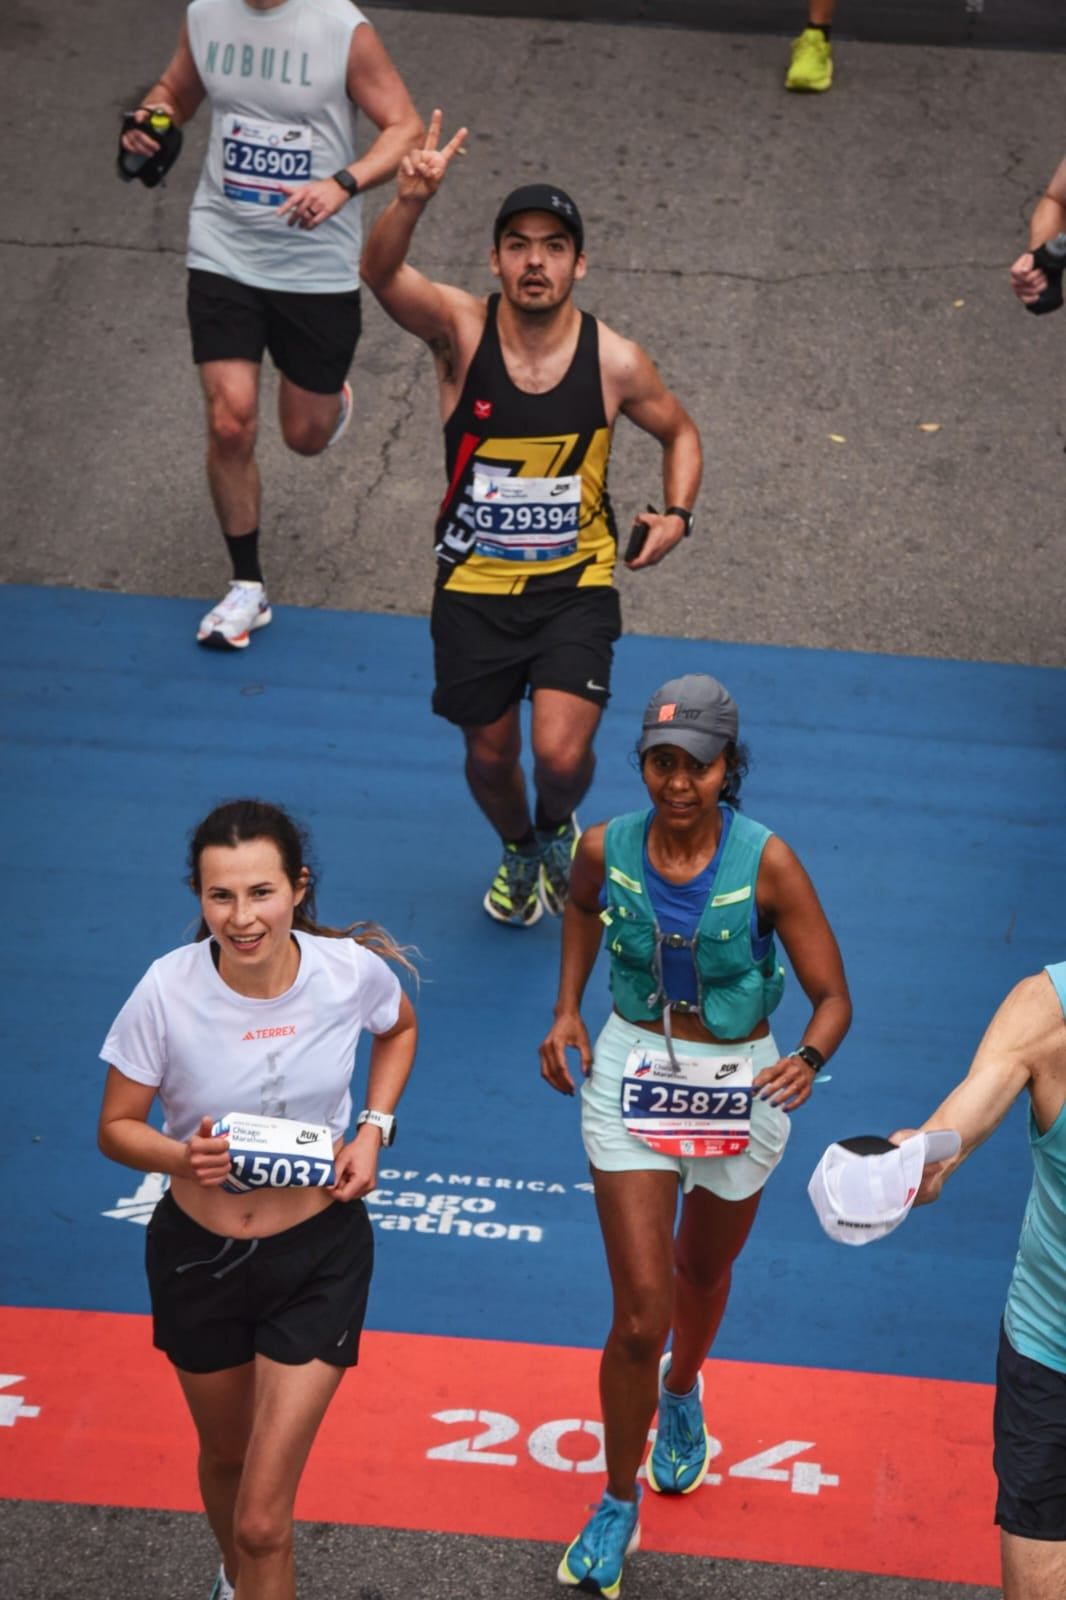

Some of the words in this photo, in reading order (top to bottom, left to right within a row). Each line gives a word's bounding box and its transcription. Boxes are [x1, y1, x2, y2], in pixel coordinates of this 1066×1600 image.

[205, 40, 312, 87] NOBULL
[224, 142, 237, 166] G
[239, 146, 309, 176] 26902
[475, 505, 494, 528] G
[499, 506, 578, 530] 29394
[256, 1025, 296, 1040] TERREX
[720, 1063, 739, 1072] RUN
[622, 1083, 643, 1113] F
[649, 1086, 749, 1115] 25873
[301, 1129, 319, 1141] RUN
[233, 1154, 332, 1188] 15037
[379, 1168, 420, 1181] OF
[425, 1172, 567, 1194] AMERICA
[365, 1188, 497, 1216] cago
[367, 1209, 544, 1243] rathon
